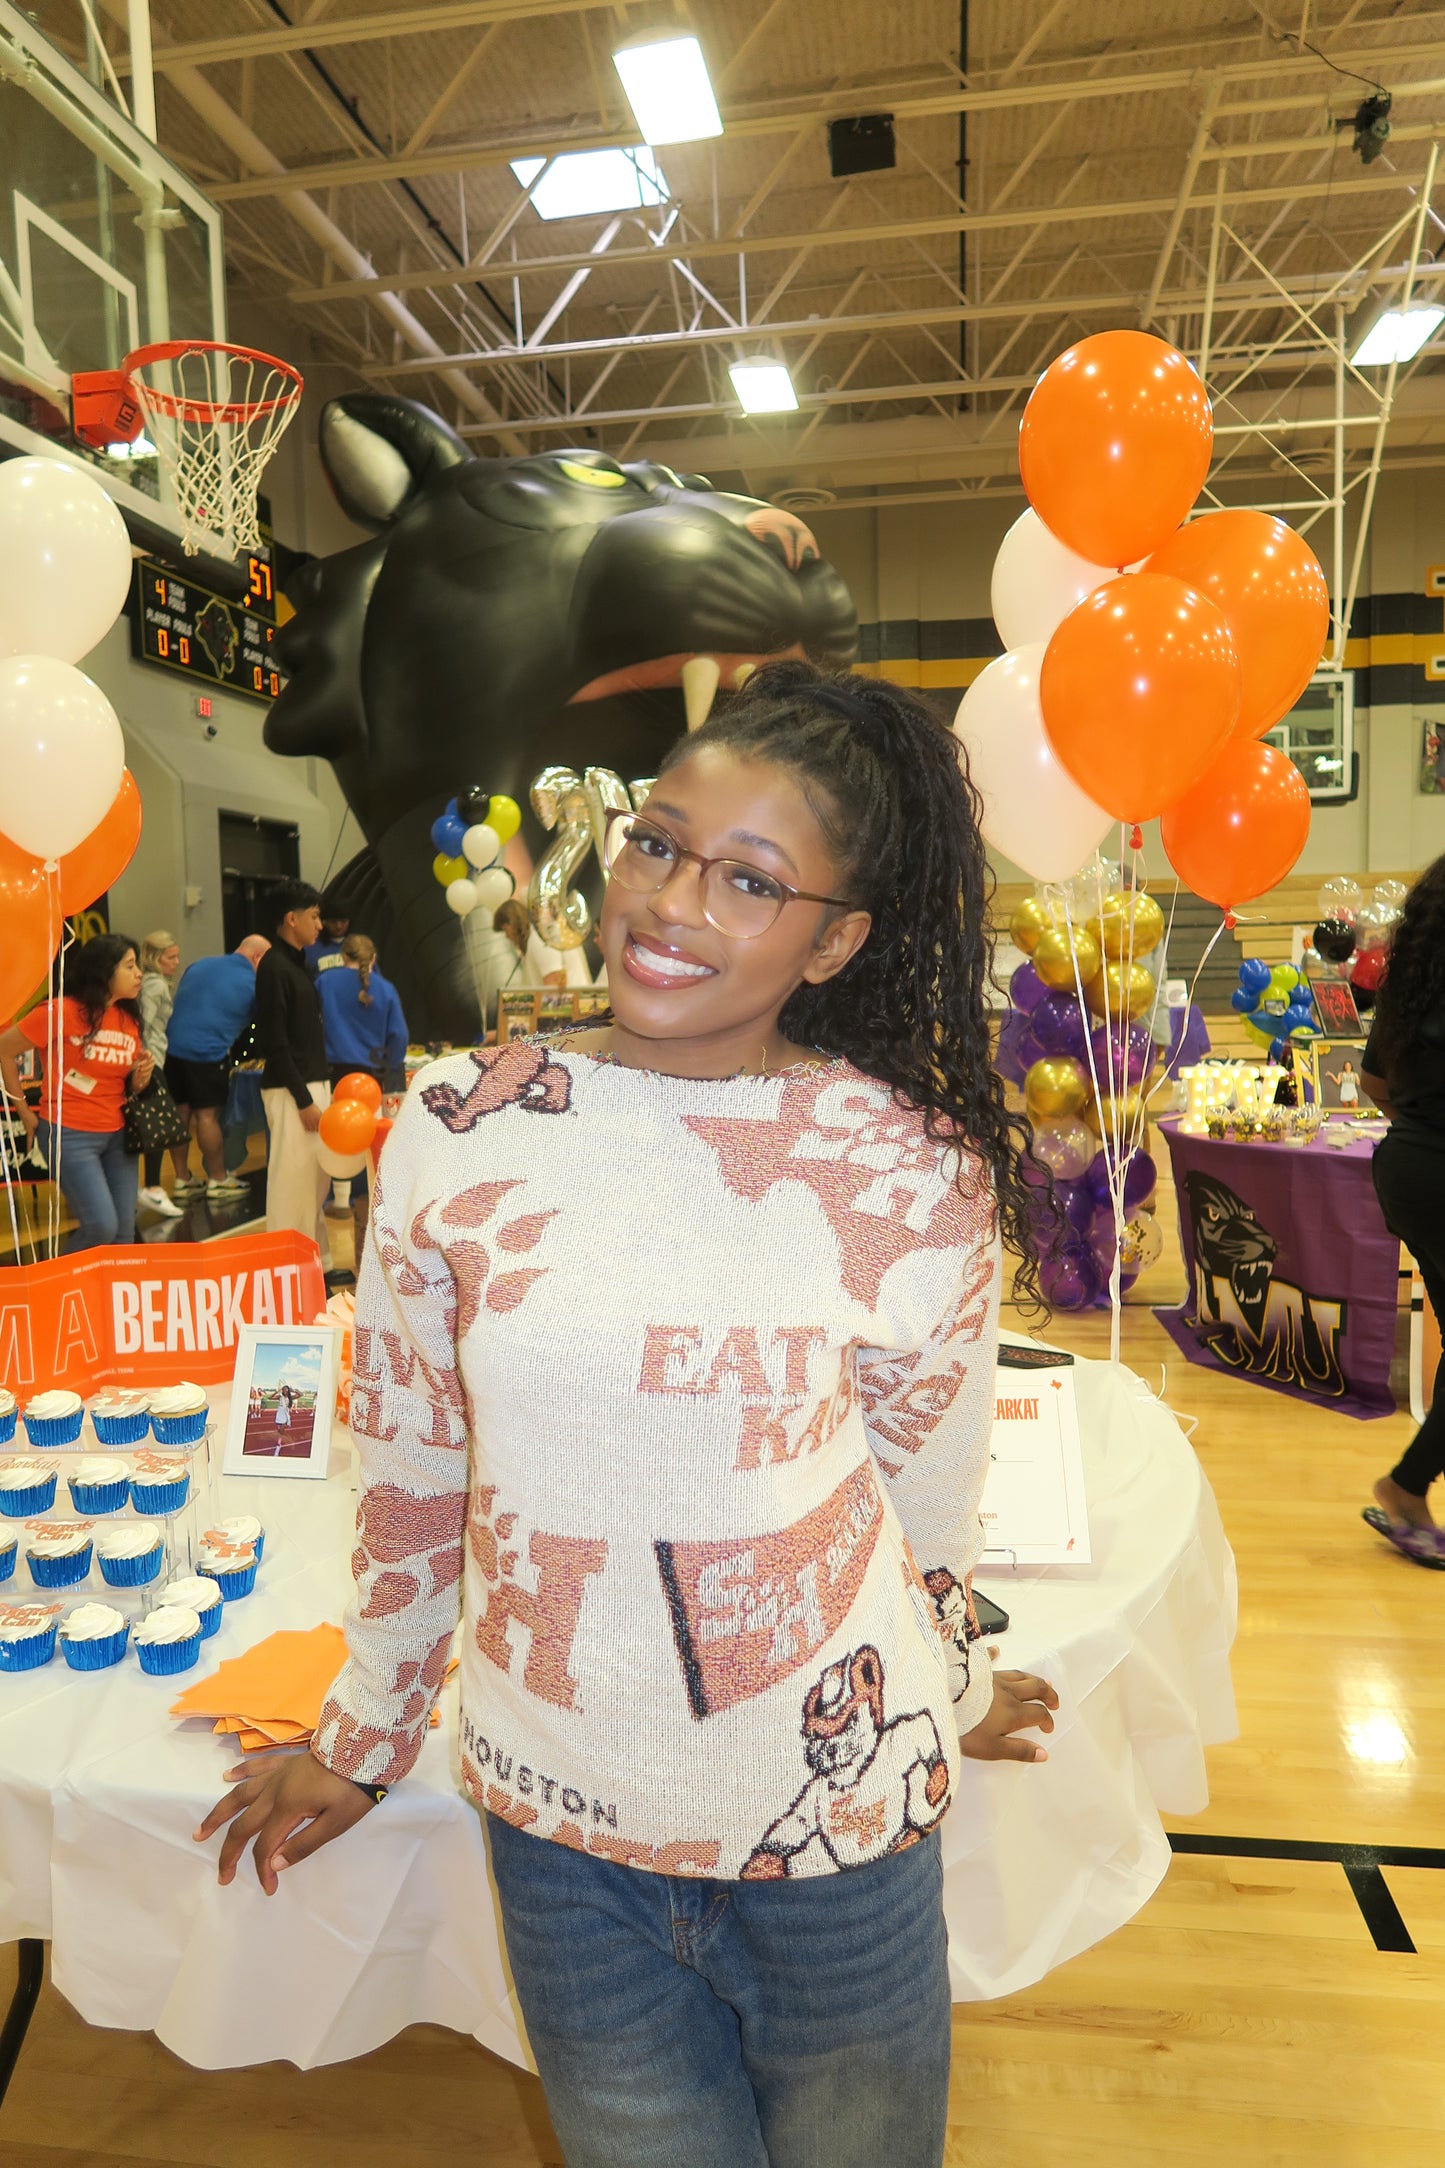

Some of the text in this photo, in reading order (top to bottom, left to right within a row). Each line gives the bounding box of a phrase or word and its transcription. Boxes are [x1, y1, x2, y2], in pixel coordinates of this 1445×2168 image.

[155, 579, 166, 606] 4
[249, 557, 272, 601] 57
[53, 1289, 99, 1376] A
[993, 1398, 1039, 1420] ARKAT
[979, 1511, 998, 1519] ston
[464, 1717, 618, 1830] HOUSTON
